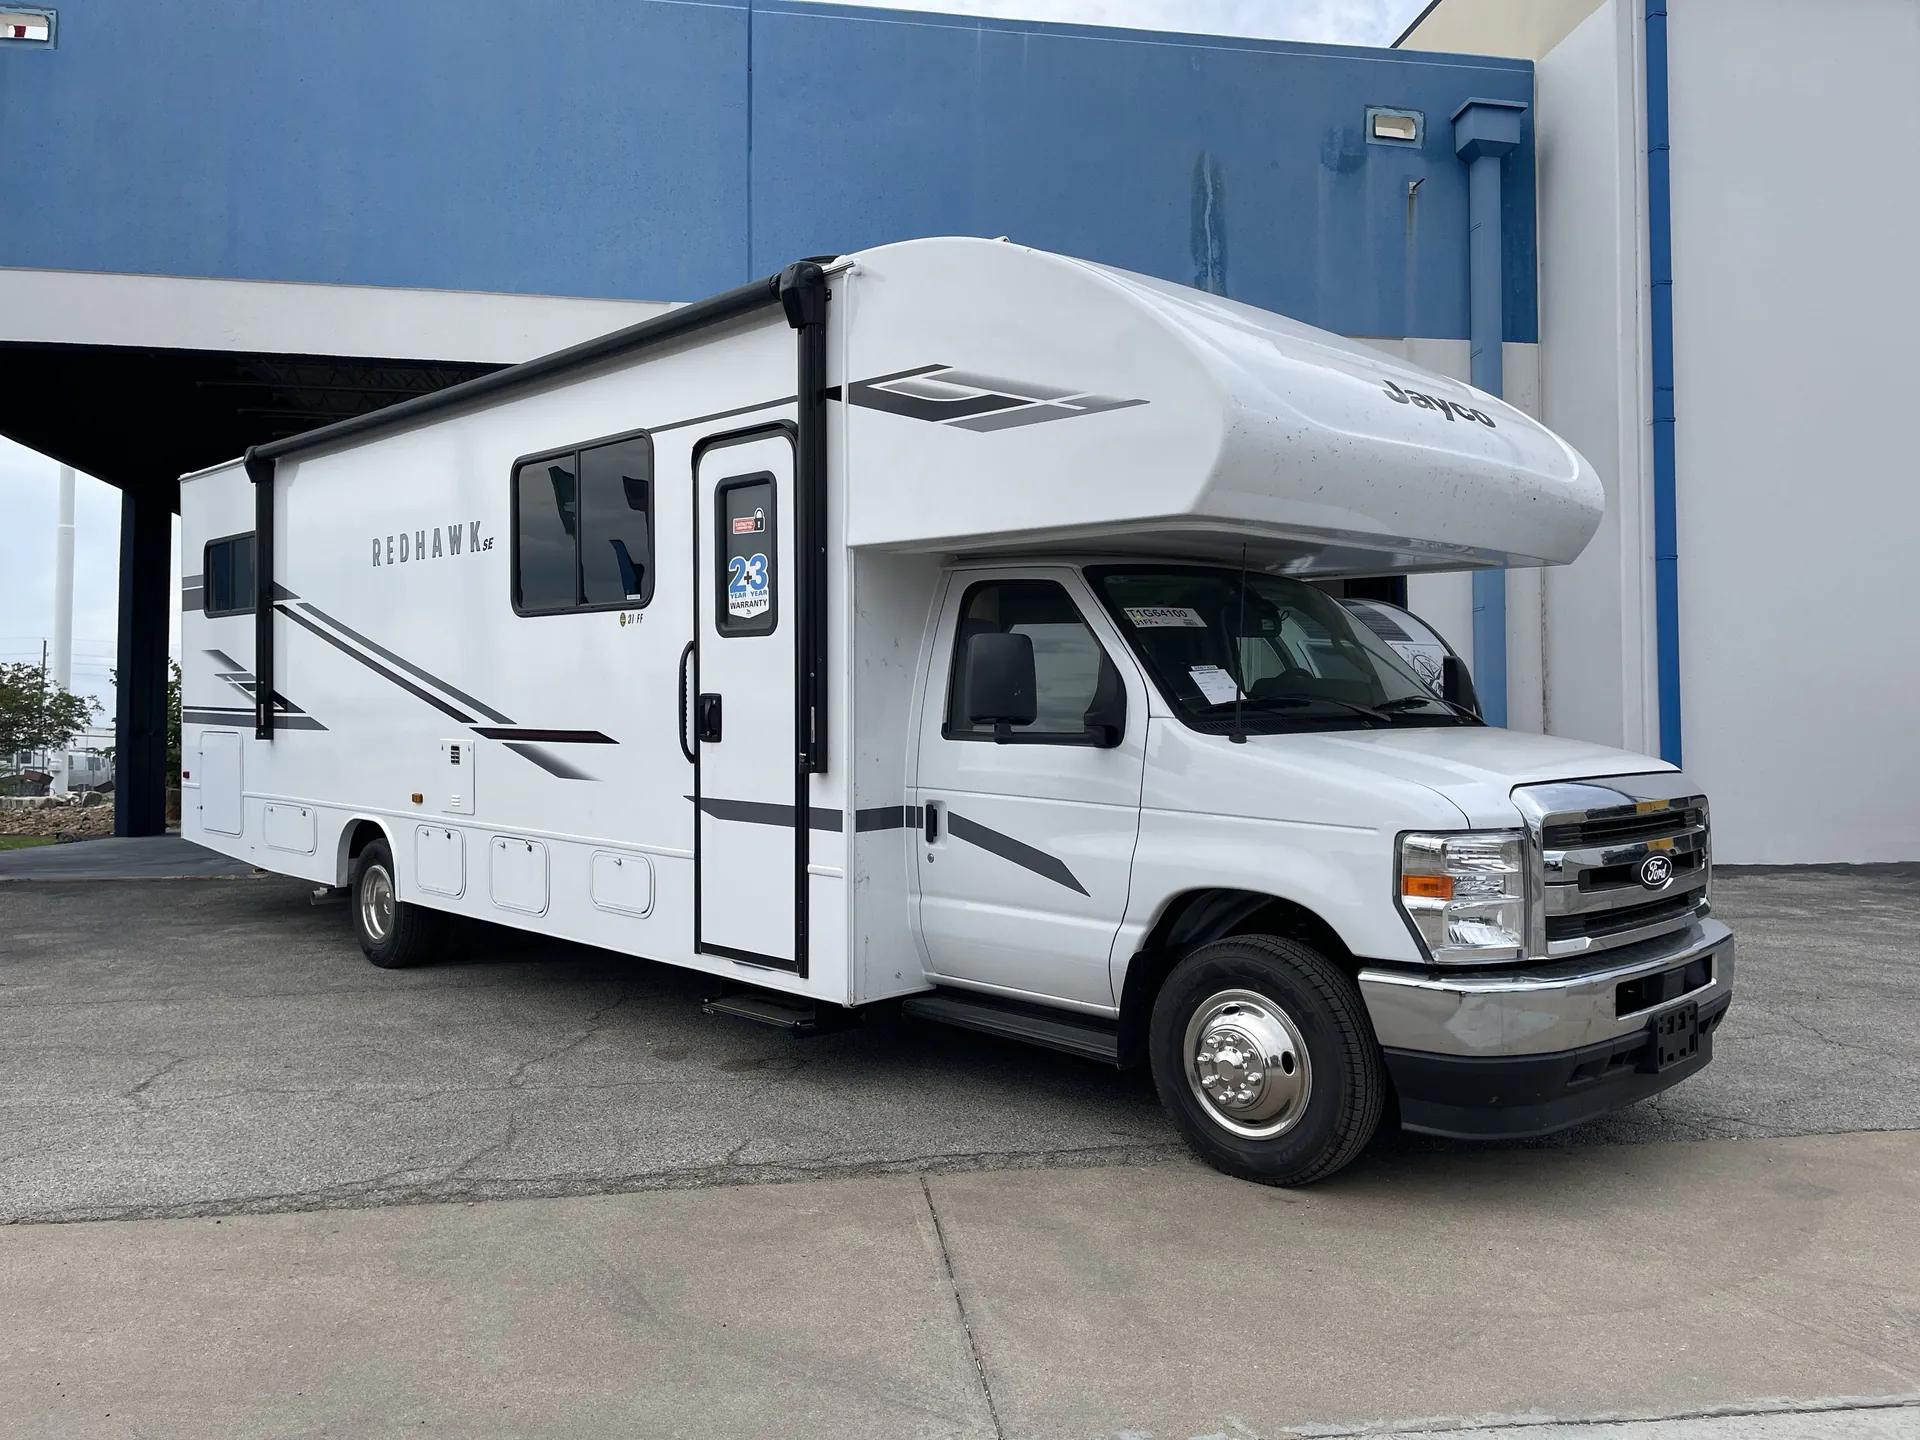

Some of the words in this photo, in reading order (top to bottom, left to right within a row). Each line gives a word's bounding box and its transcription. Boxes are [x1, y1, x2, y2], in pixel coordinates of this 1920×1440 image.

[1382, 379, 1497, 429] Jayco
[372, 520, 482, 567] REDHAWK
[482, 537, 494, 552] SE
[730, 592, 747, 600] YEAR
[750, 589, 768, 598] YEAR
[729, 599, 768, 610] WARRANTY
[636, 613, 644, 624] FF
[1126, 609, 1188, 618] T1G64100
[1647, 860, 1668, 882] Ford
